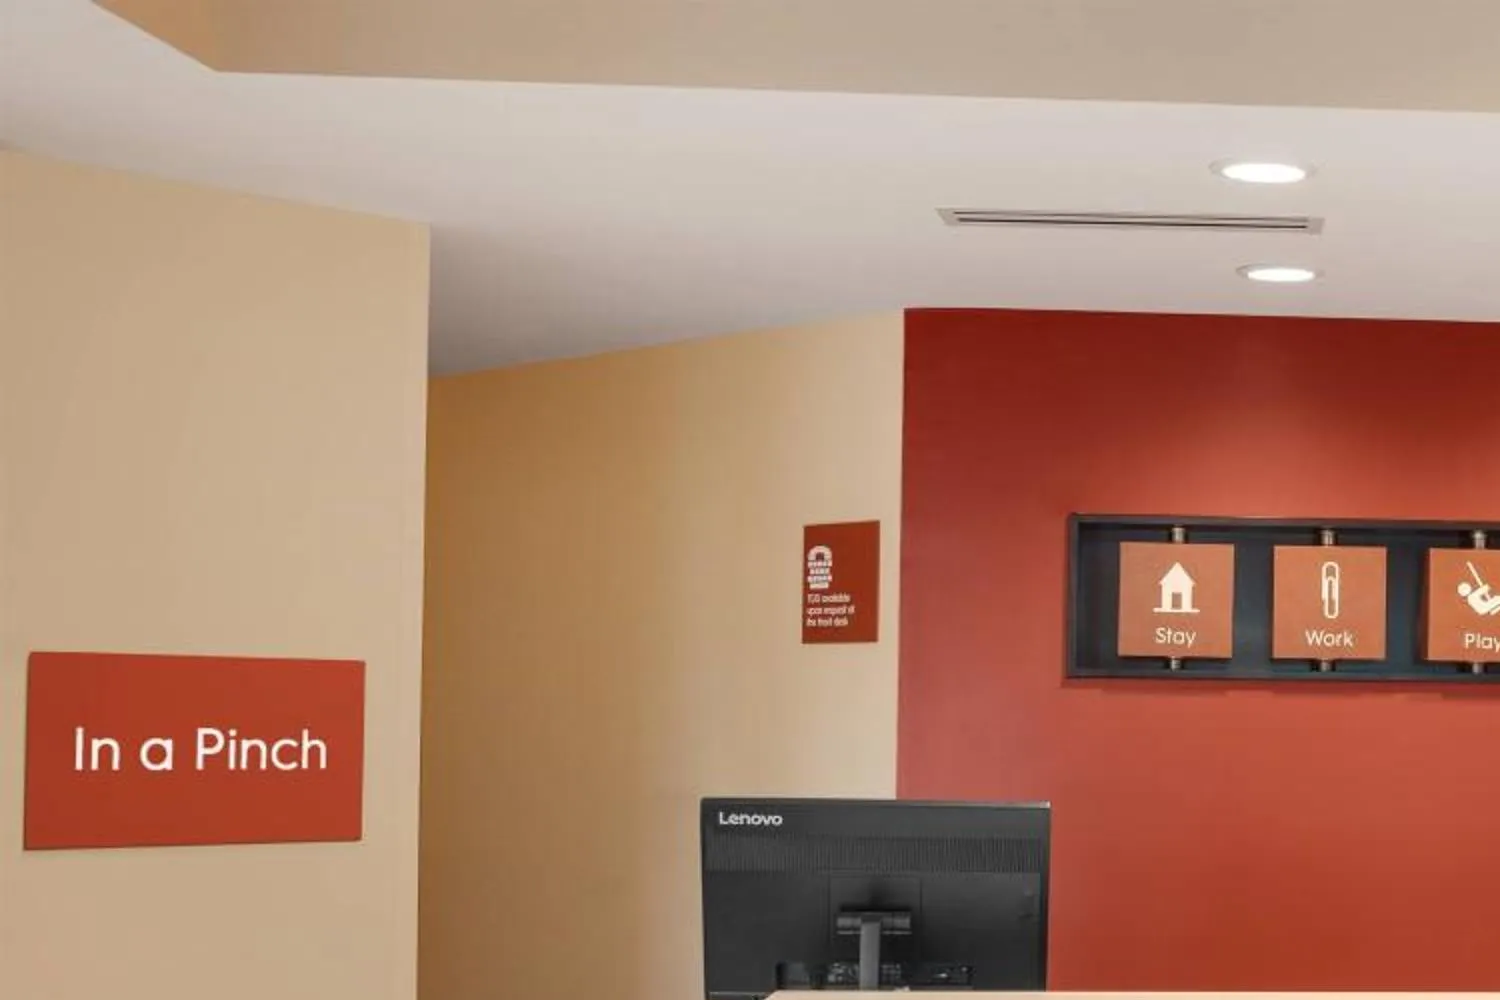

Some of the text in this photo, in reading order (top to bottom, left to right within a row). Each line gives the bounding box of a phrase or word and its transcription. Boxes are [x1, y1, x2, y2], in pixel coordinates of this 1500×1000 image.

[1155, 627, 1198, 649] Stay
[1304, 629, 1354, 648] Work
[75, 726, 327, 771] In a Pinch
[719, 811, 784, 826] Lenovo
